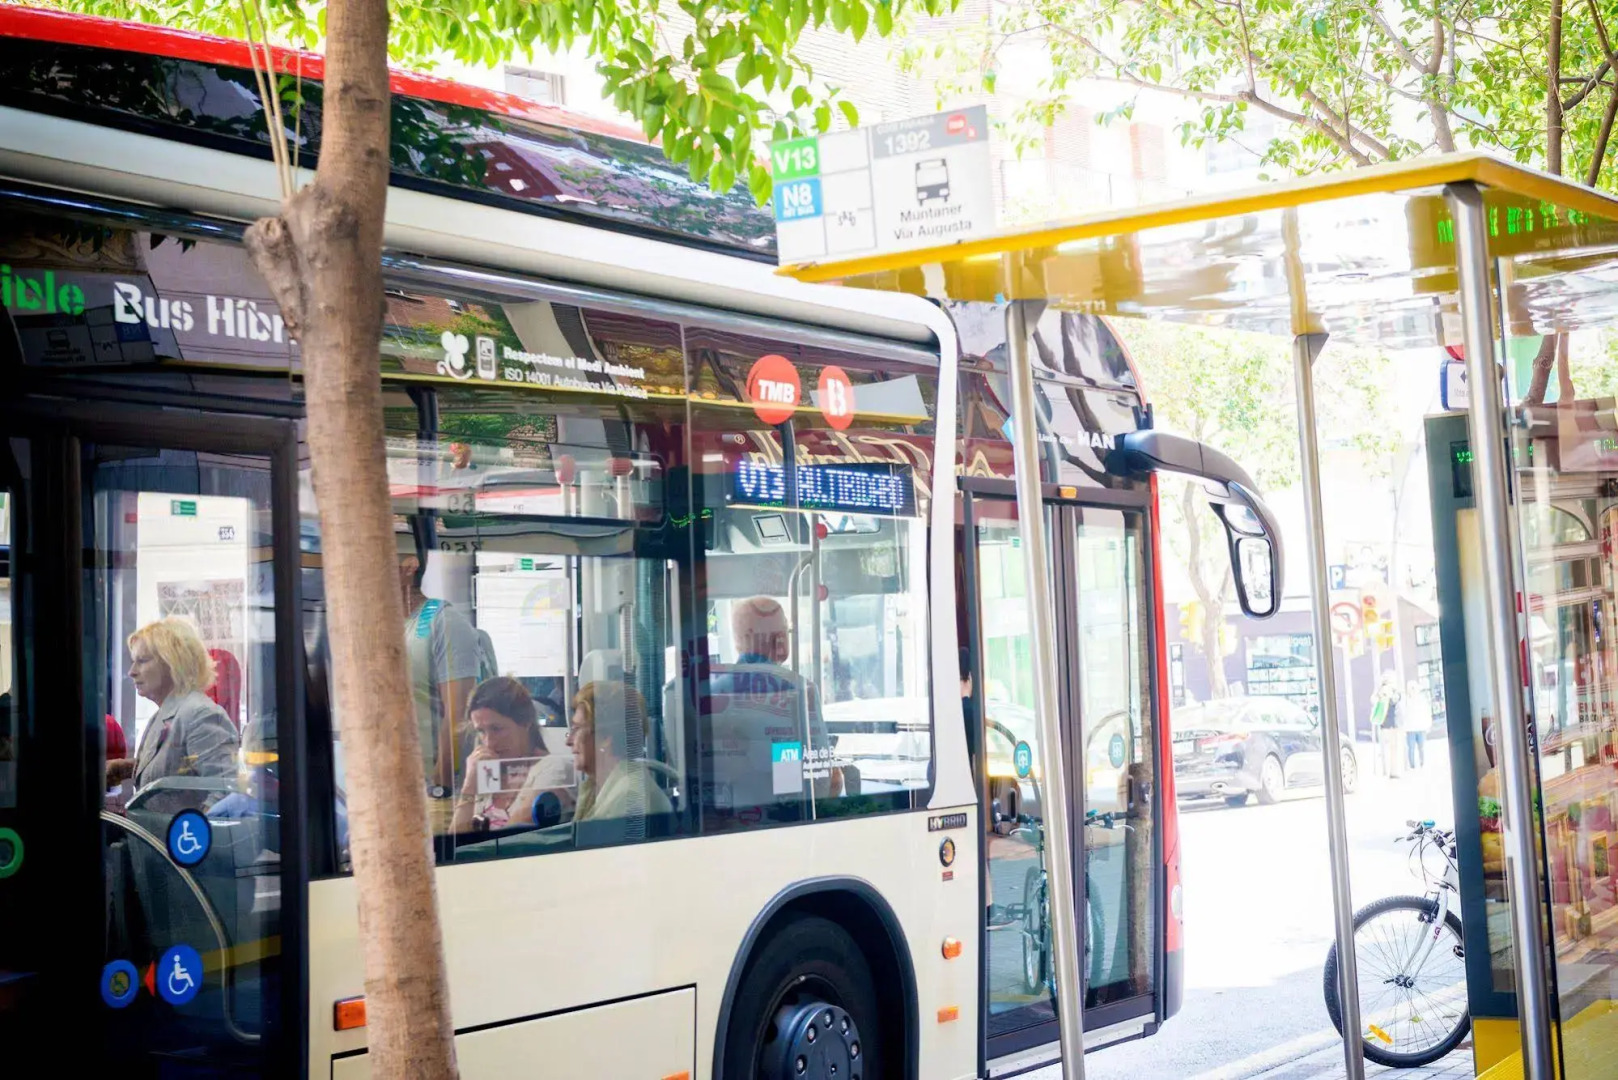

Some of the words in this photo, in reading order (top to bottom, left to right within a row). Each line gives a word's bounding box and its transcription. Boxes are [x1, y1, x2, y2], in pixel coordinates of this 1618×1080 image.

[884, 130, 931, 155] 1392
[774, 147, 816, 174] V13
[782, 182, 812, 208] N8
[900, 204, 962, 222] Muntaner
[894, 228, 914, 240] Via
[918, 219, 972, 239] Augusta
[113, 281, 194, 333] Bus
[206, 294, 297, 346] Híbr
[504, 368, 523, 382] ISO
[525, 371, 551, 386] 14001
[758, 379, 795, 404] TMB
[826, 378, 847, 417] B
[1077, 430, 1116, 450] MAN
[738, 460, 785, 499] V13
[780, 748, 798, 762] ATM
[929, 814, 966, 830] HYBRID
